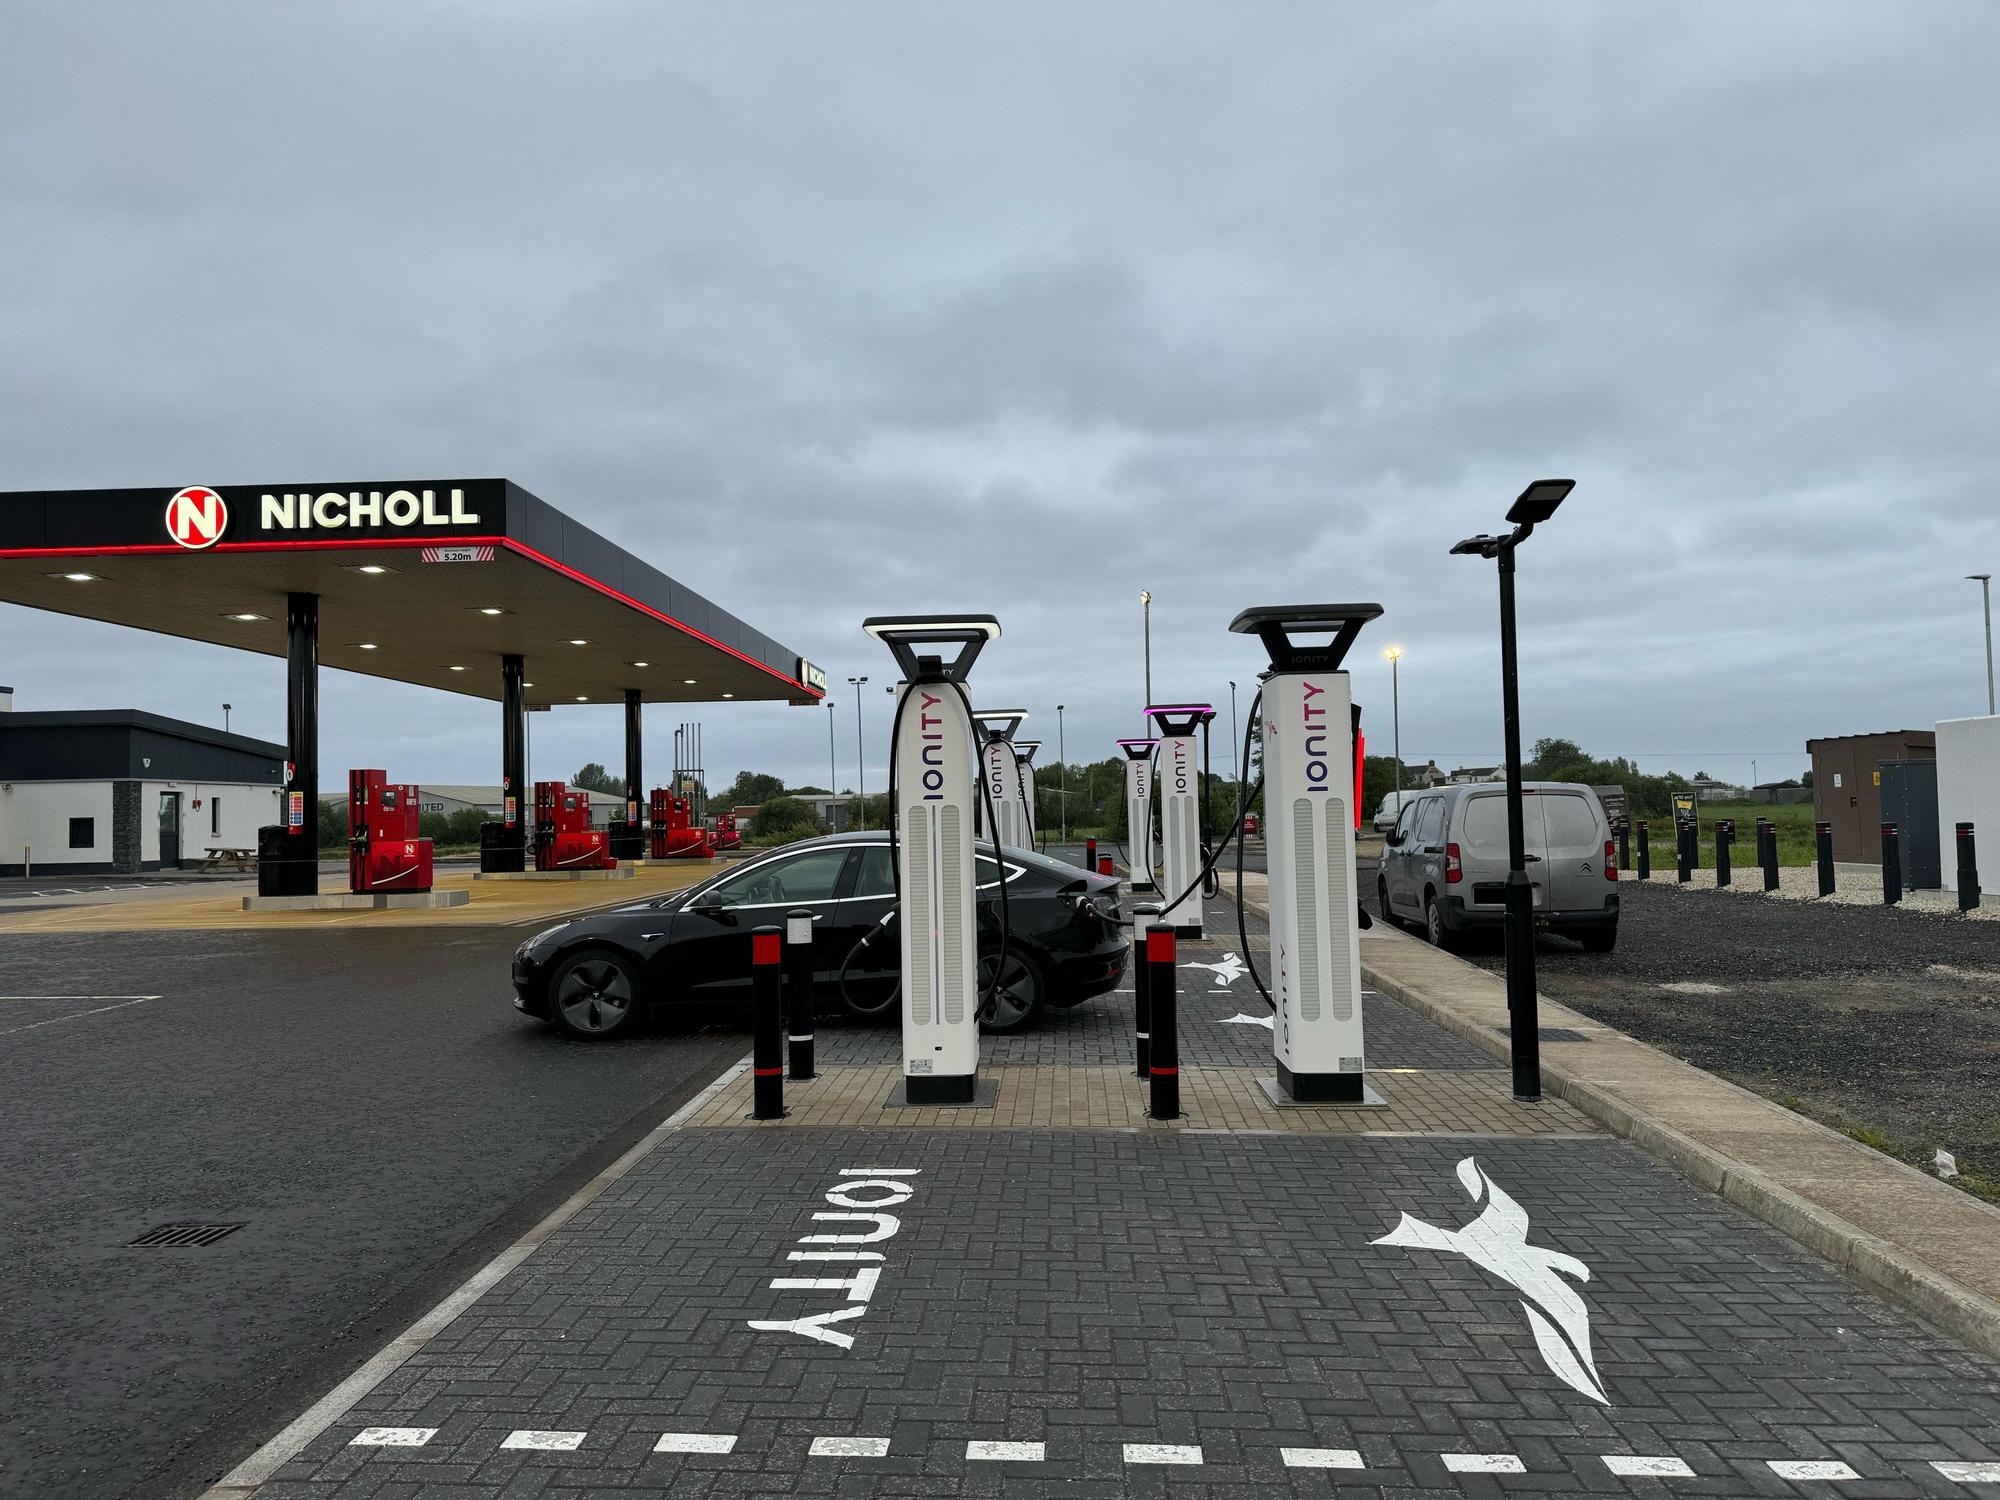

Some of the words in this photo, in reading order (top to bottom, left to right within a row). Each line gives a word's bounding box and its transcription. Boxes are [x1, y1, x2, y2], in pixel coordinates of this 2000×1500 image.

[177, 496, 216, 539] N
[261, 489, 480, 529] NICHOLL
[444, 553, 471, 561] 5.20m
[920, 692, 943, 800] IONITY
[1303, 681, 1328, 791] IONITY
[991, 746, 1003, 799] IONITY
[1136, 762, 1145, 797] IONITY
[1174, 741, 1186, 793] IONITY
[747, 1168, 922, 1350] IONITY
